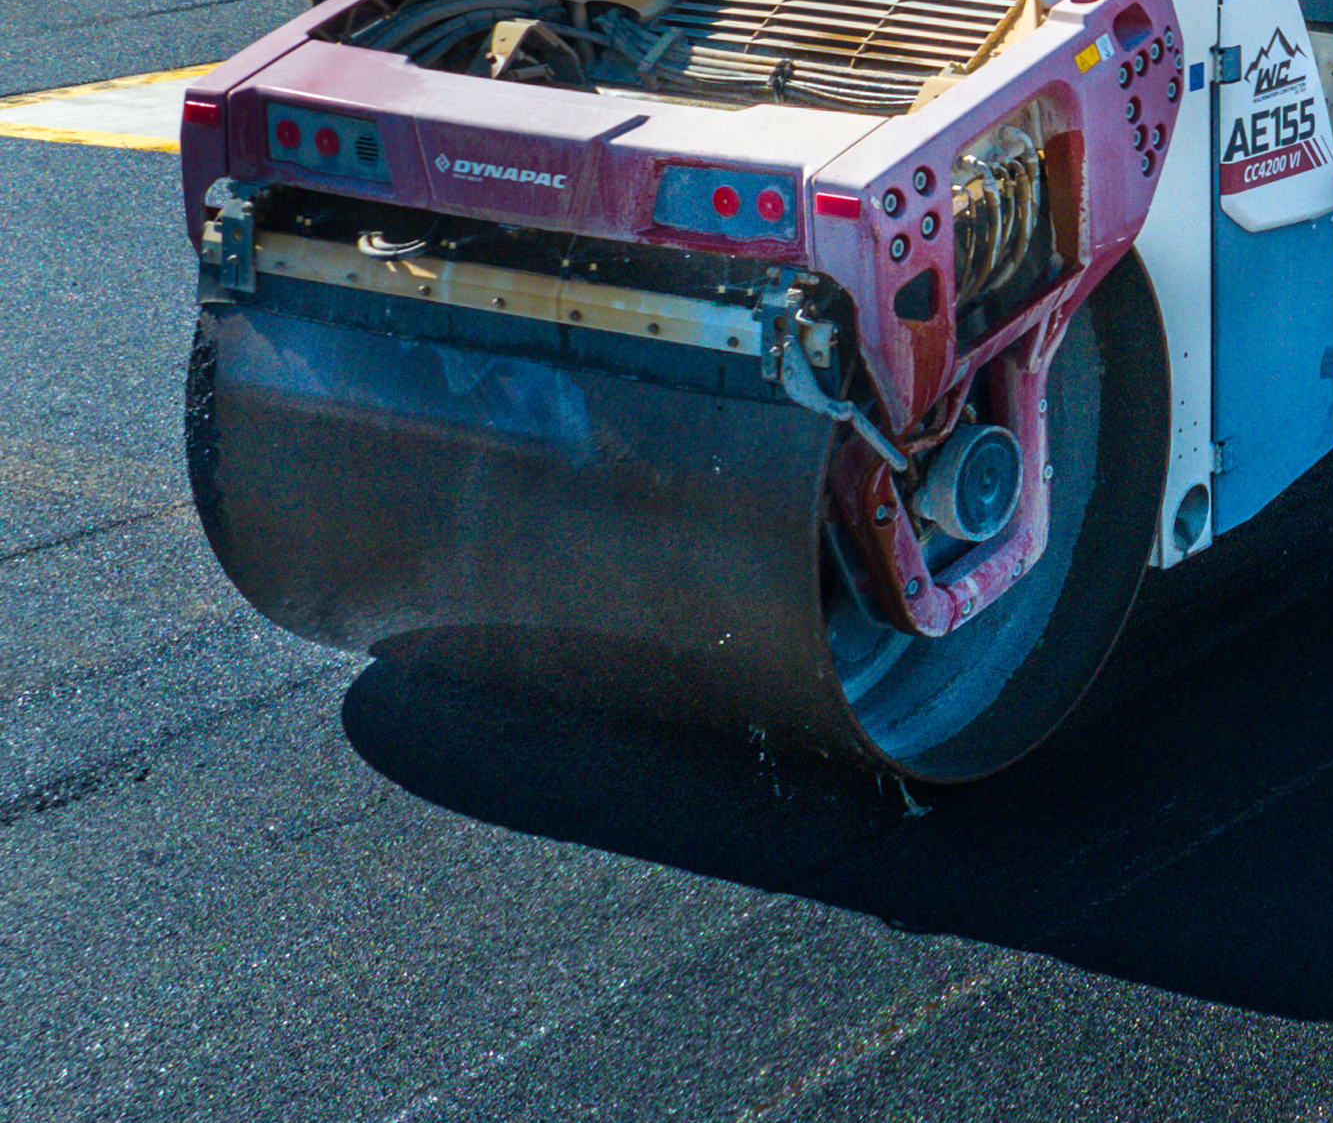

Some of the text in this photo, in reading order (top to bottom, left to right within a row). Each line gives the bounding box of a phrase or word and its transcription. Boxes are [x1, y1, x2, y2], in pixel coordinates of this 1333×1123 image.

[1254, 59, 1298, 96] WC
[1222, 97, 1315, 162] AE155
[452, 159, 568, 189] DYNAPAC
[1243, 150, 1301, 183] CC4200 VI
